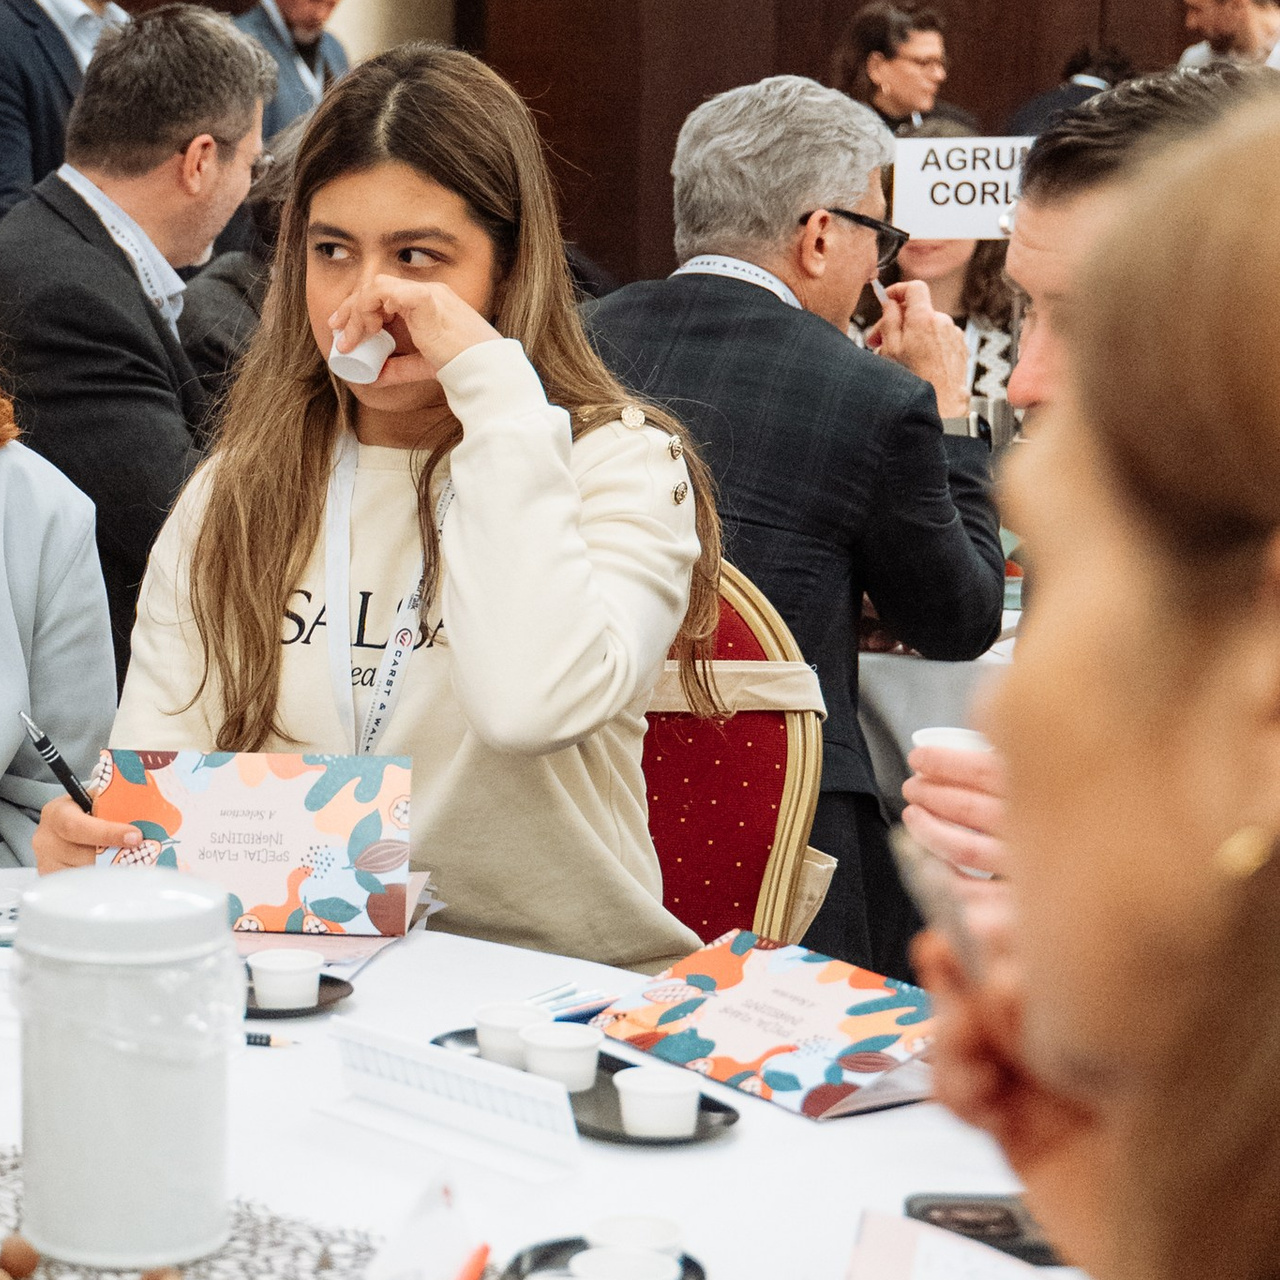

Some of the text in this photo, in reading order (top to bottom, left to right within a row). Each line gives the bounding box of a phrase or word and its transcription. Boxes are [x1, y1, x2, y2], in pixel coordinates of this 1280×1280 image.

[384, 650, 403, 696] CARST
[379, 702, 386, 711] &
[220, 809, 266, 820] Selection
